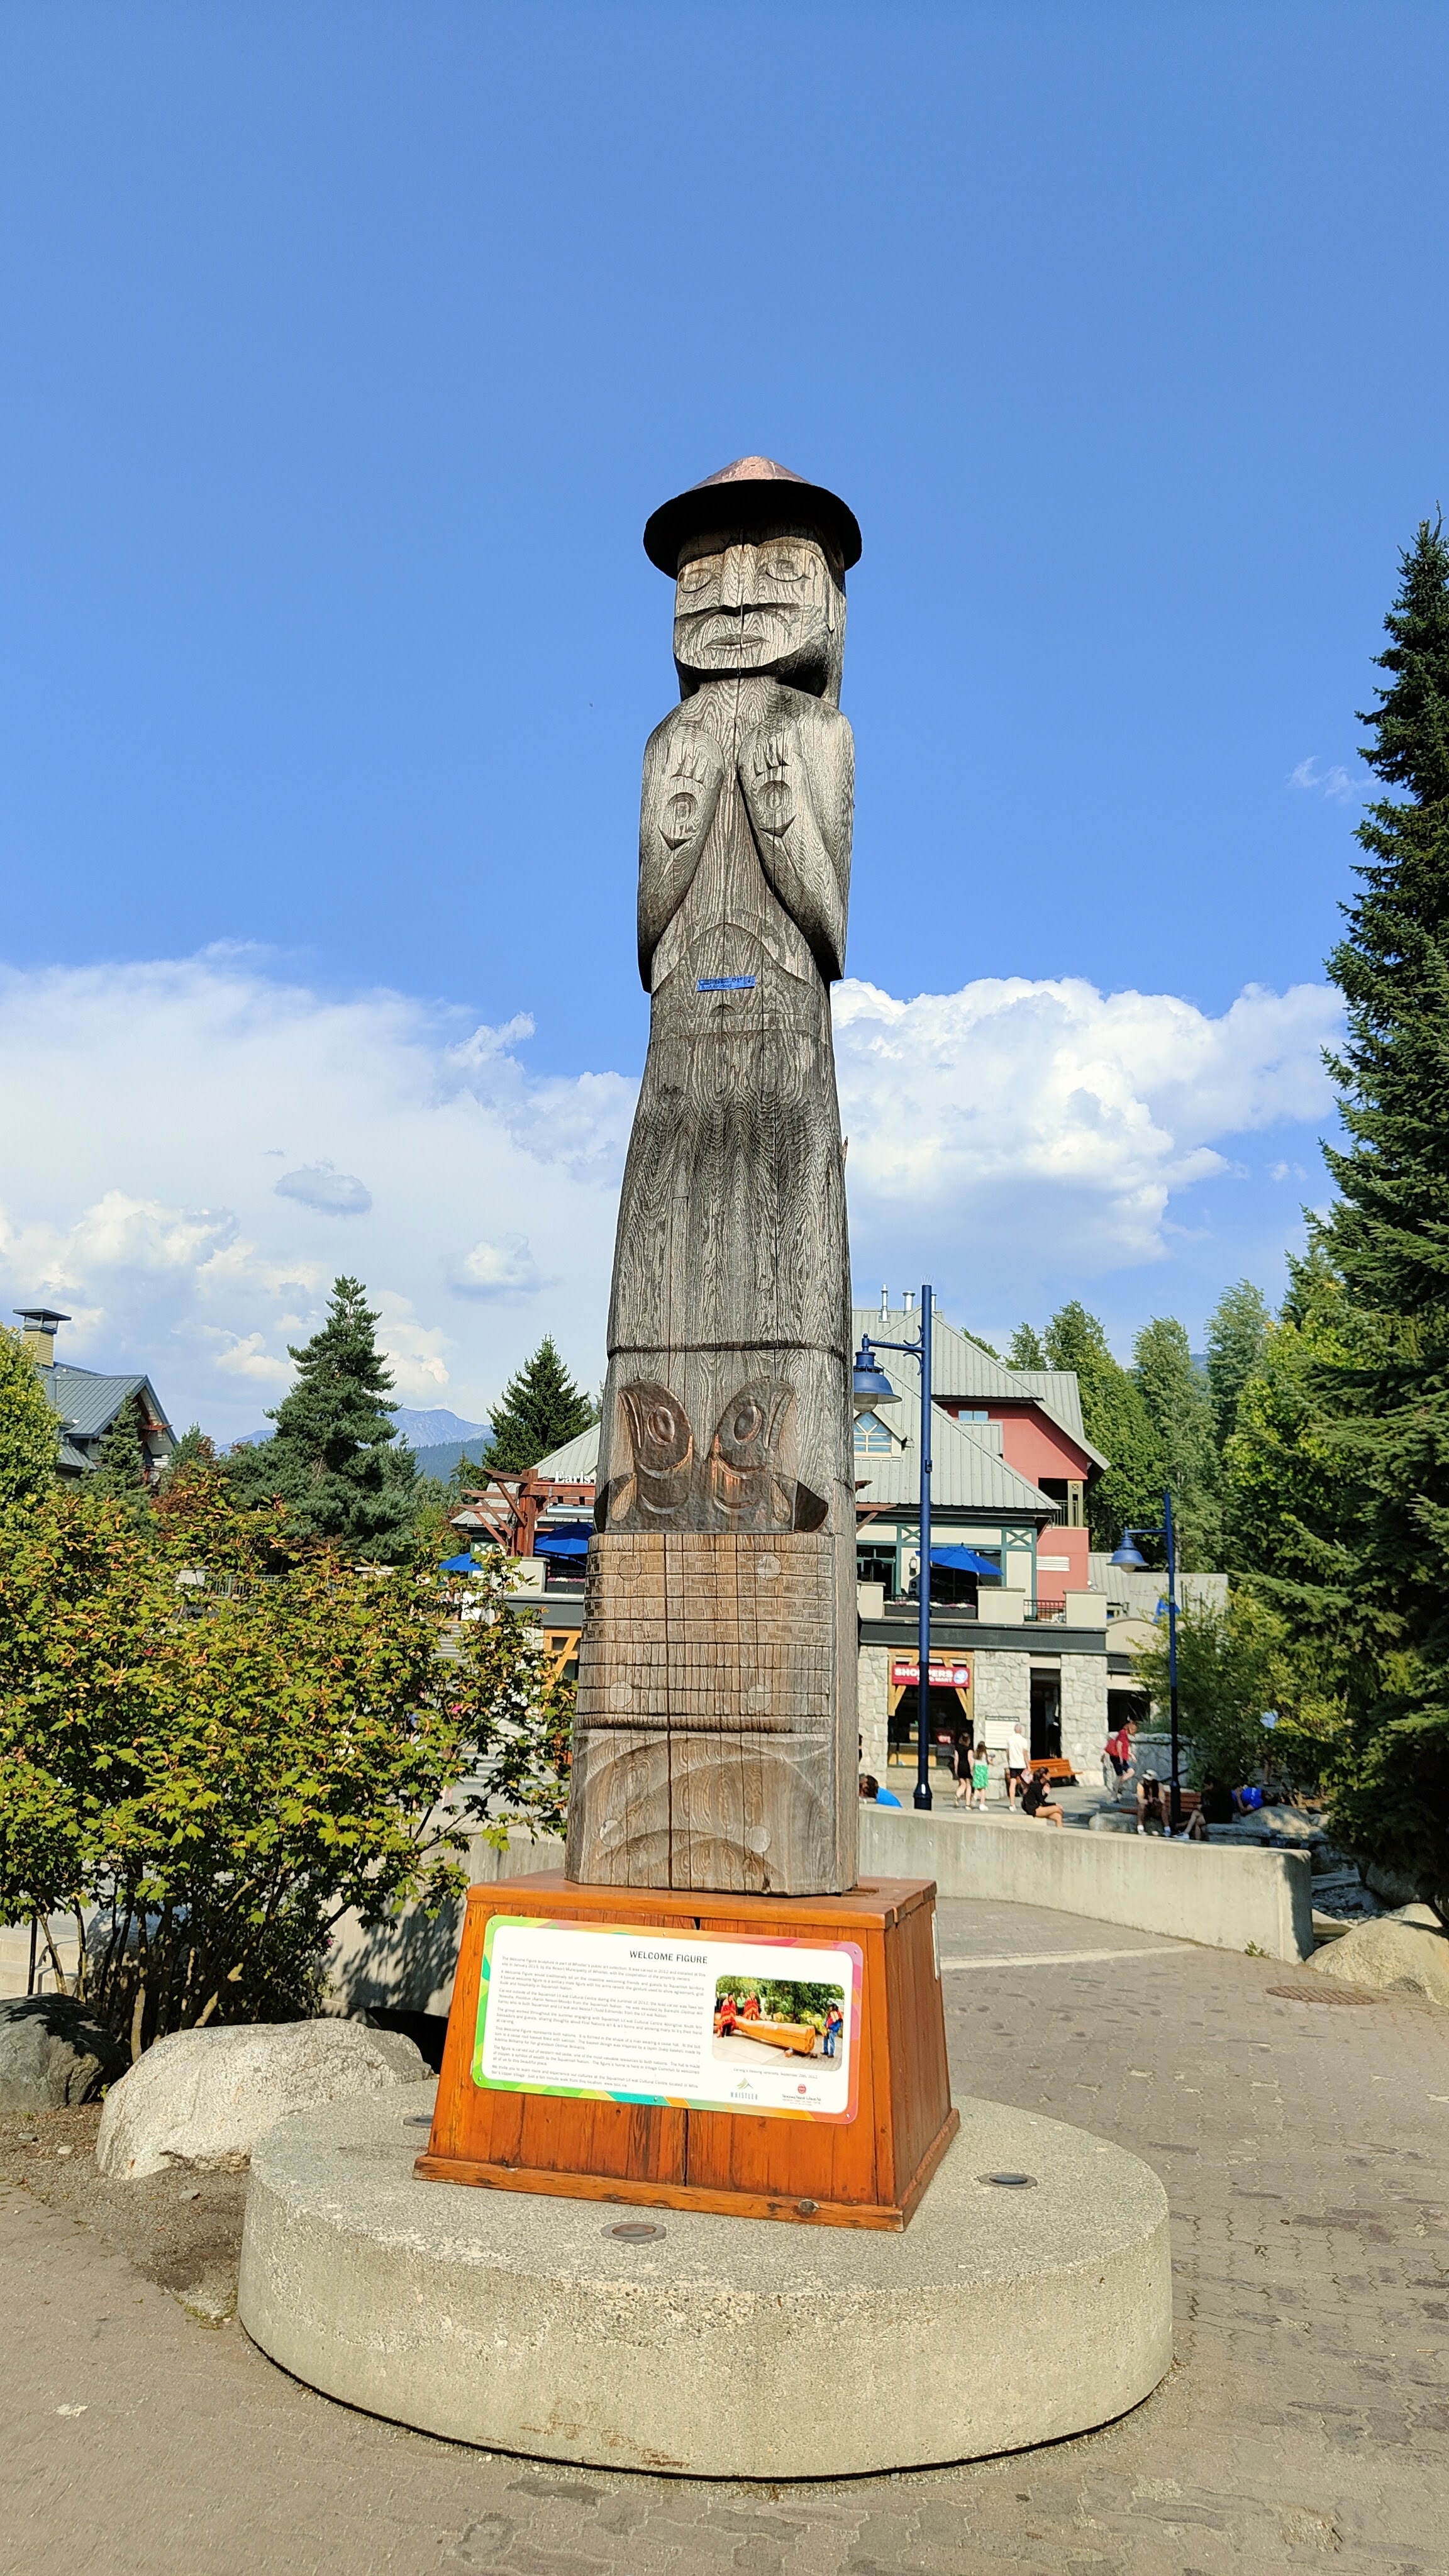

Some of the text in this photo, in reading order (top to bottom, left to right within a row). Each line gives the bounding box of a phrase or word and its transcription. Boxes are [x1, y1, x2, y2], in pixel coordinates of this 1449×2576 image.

[554, 1471, 591, 1484] Earls
[630, 1950, 708, 1964] WELCOME FIGURE
